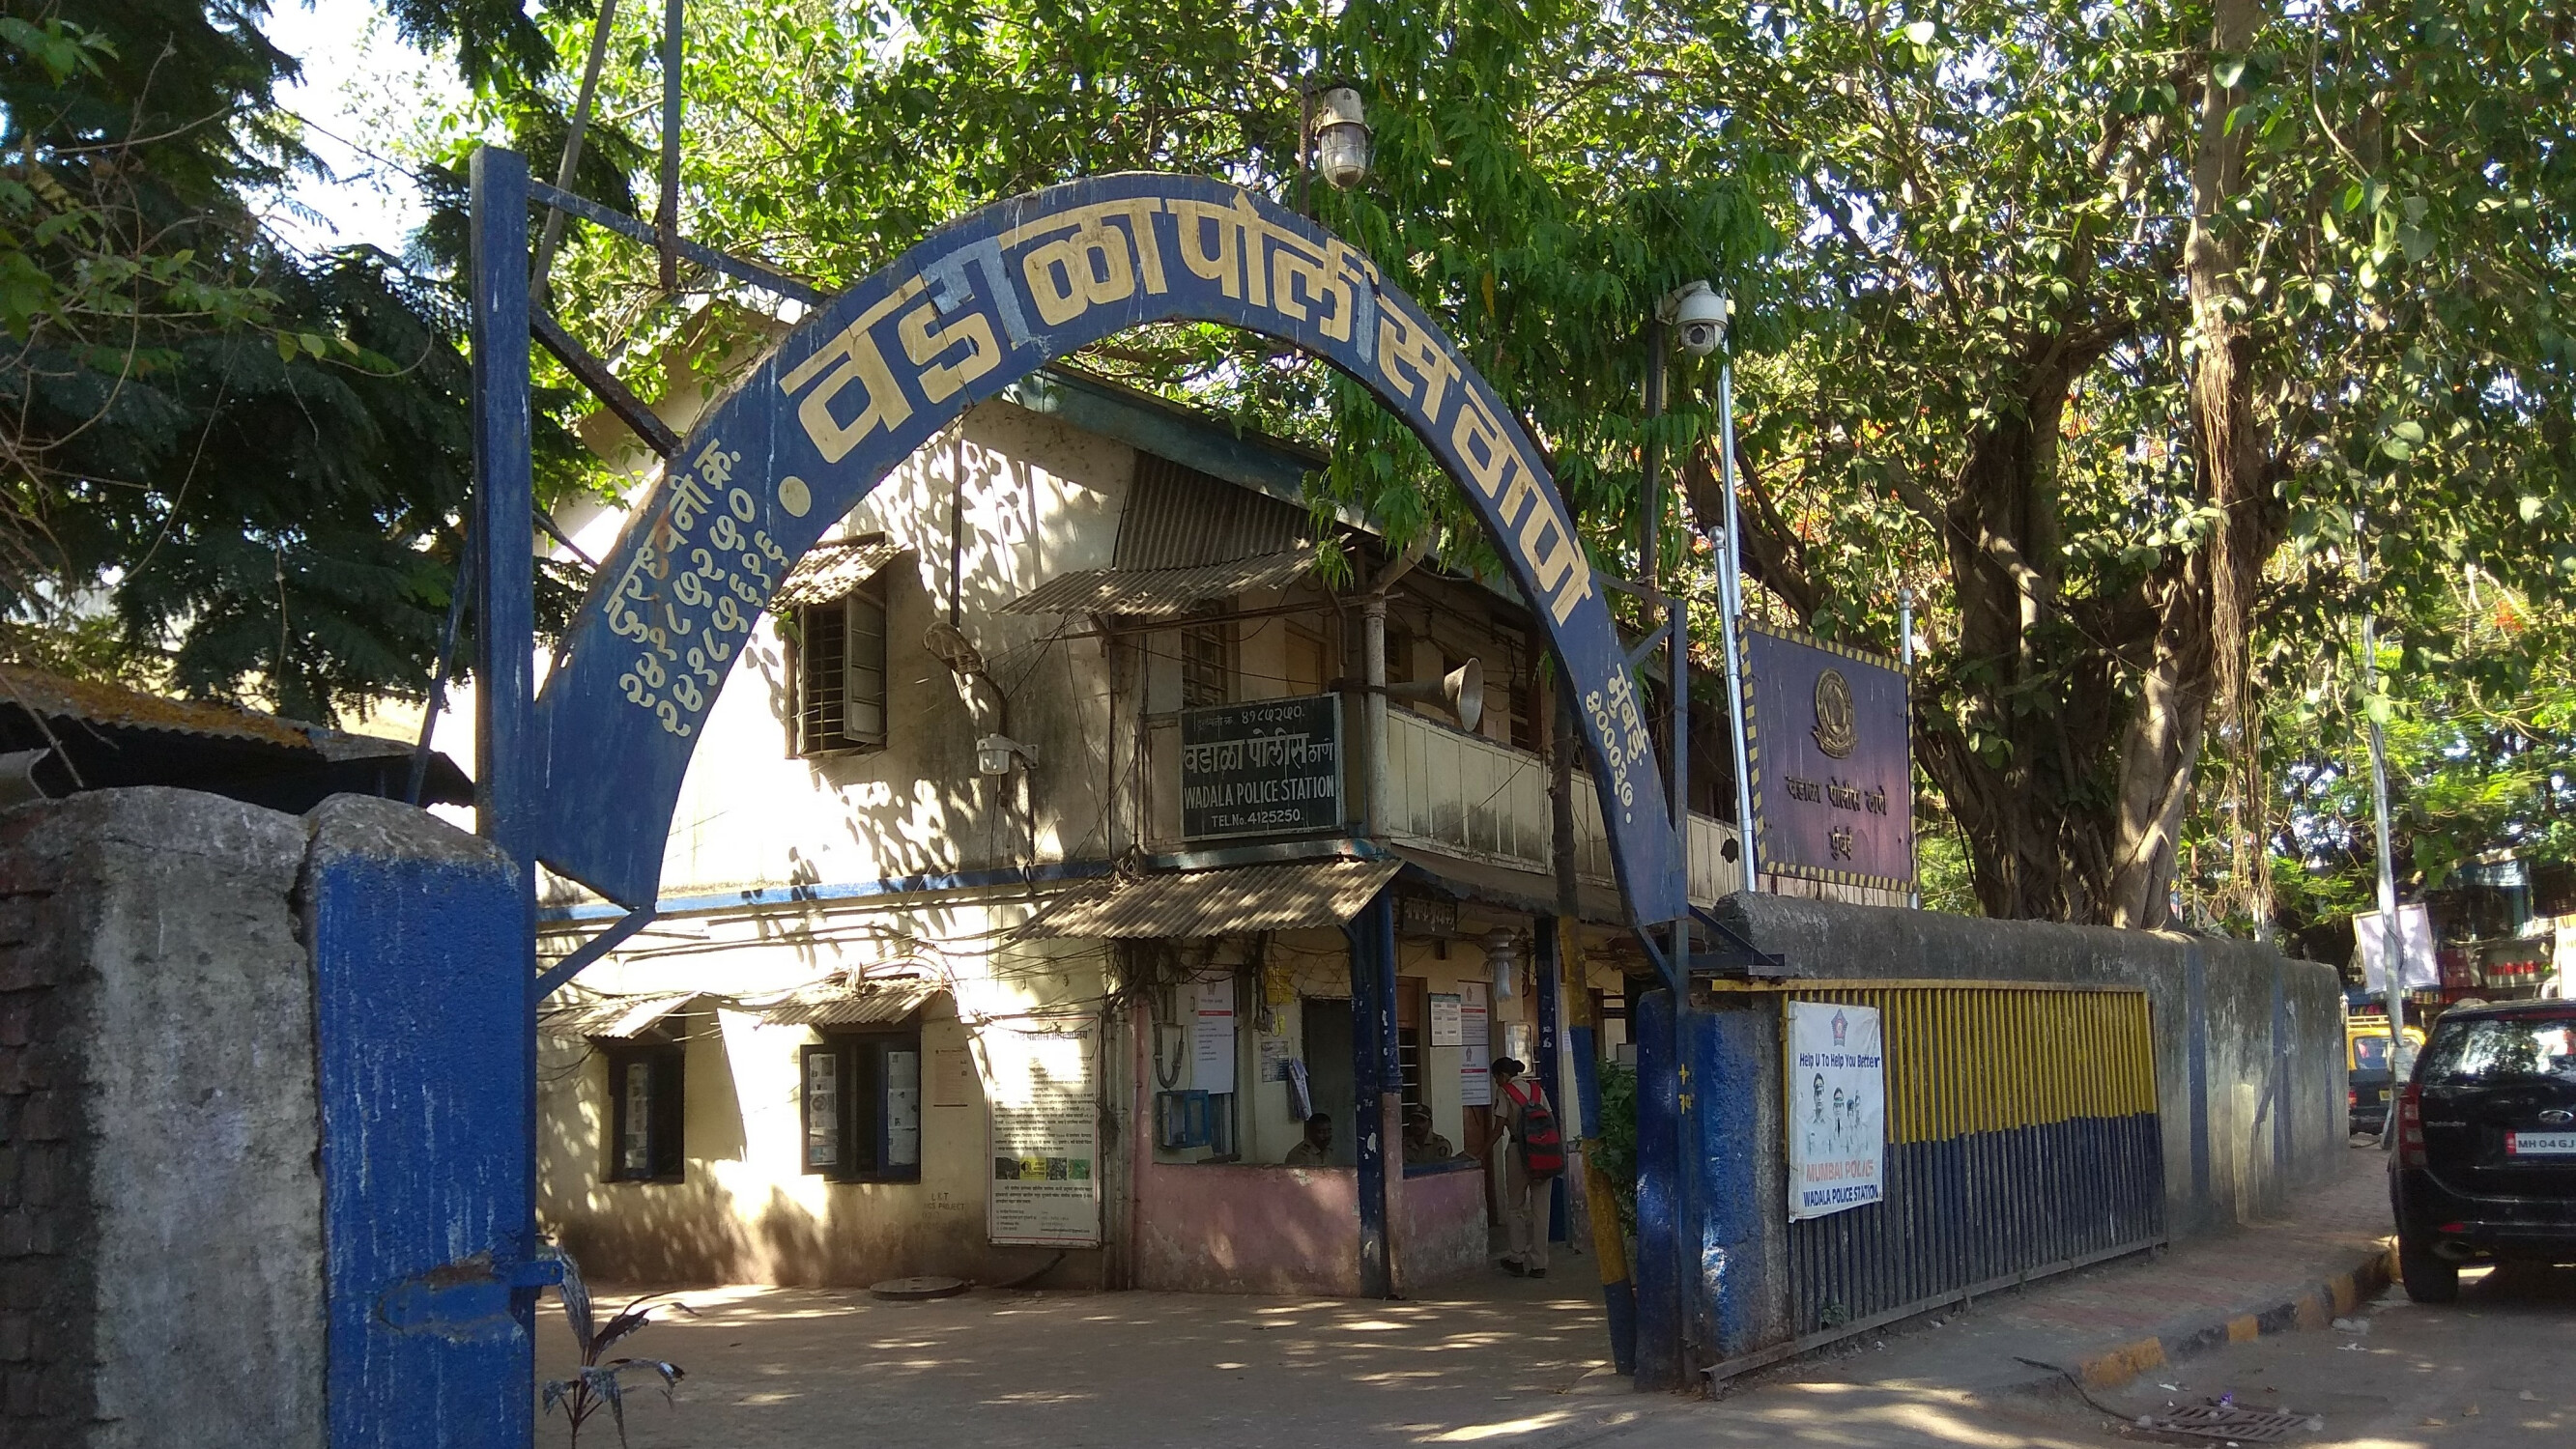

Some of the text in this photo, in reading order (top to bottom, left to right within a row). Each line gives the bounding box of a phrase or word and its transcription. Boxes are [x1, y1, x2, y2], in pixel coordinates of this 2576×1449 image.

[779, 188, 1592, 627] वडाळा पोलीस ठाणे
[1184, 727, 1333, 773] वडाळा पोलीस ठाणे
[1185, 775, 1334, 810] WADALA POLICE STATION
[1799, 1053, 1880, 1069] Help U To Help You Better
[2559, 1139, 2575, 1148] GJ
[1806, 1161, 1843, 1182] MUMBAI
[1803, 1184, 1878, 1208] WADALA POLICE STATION
